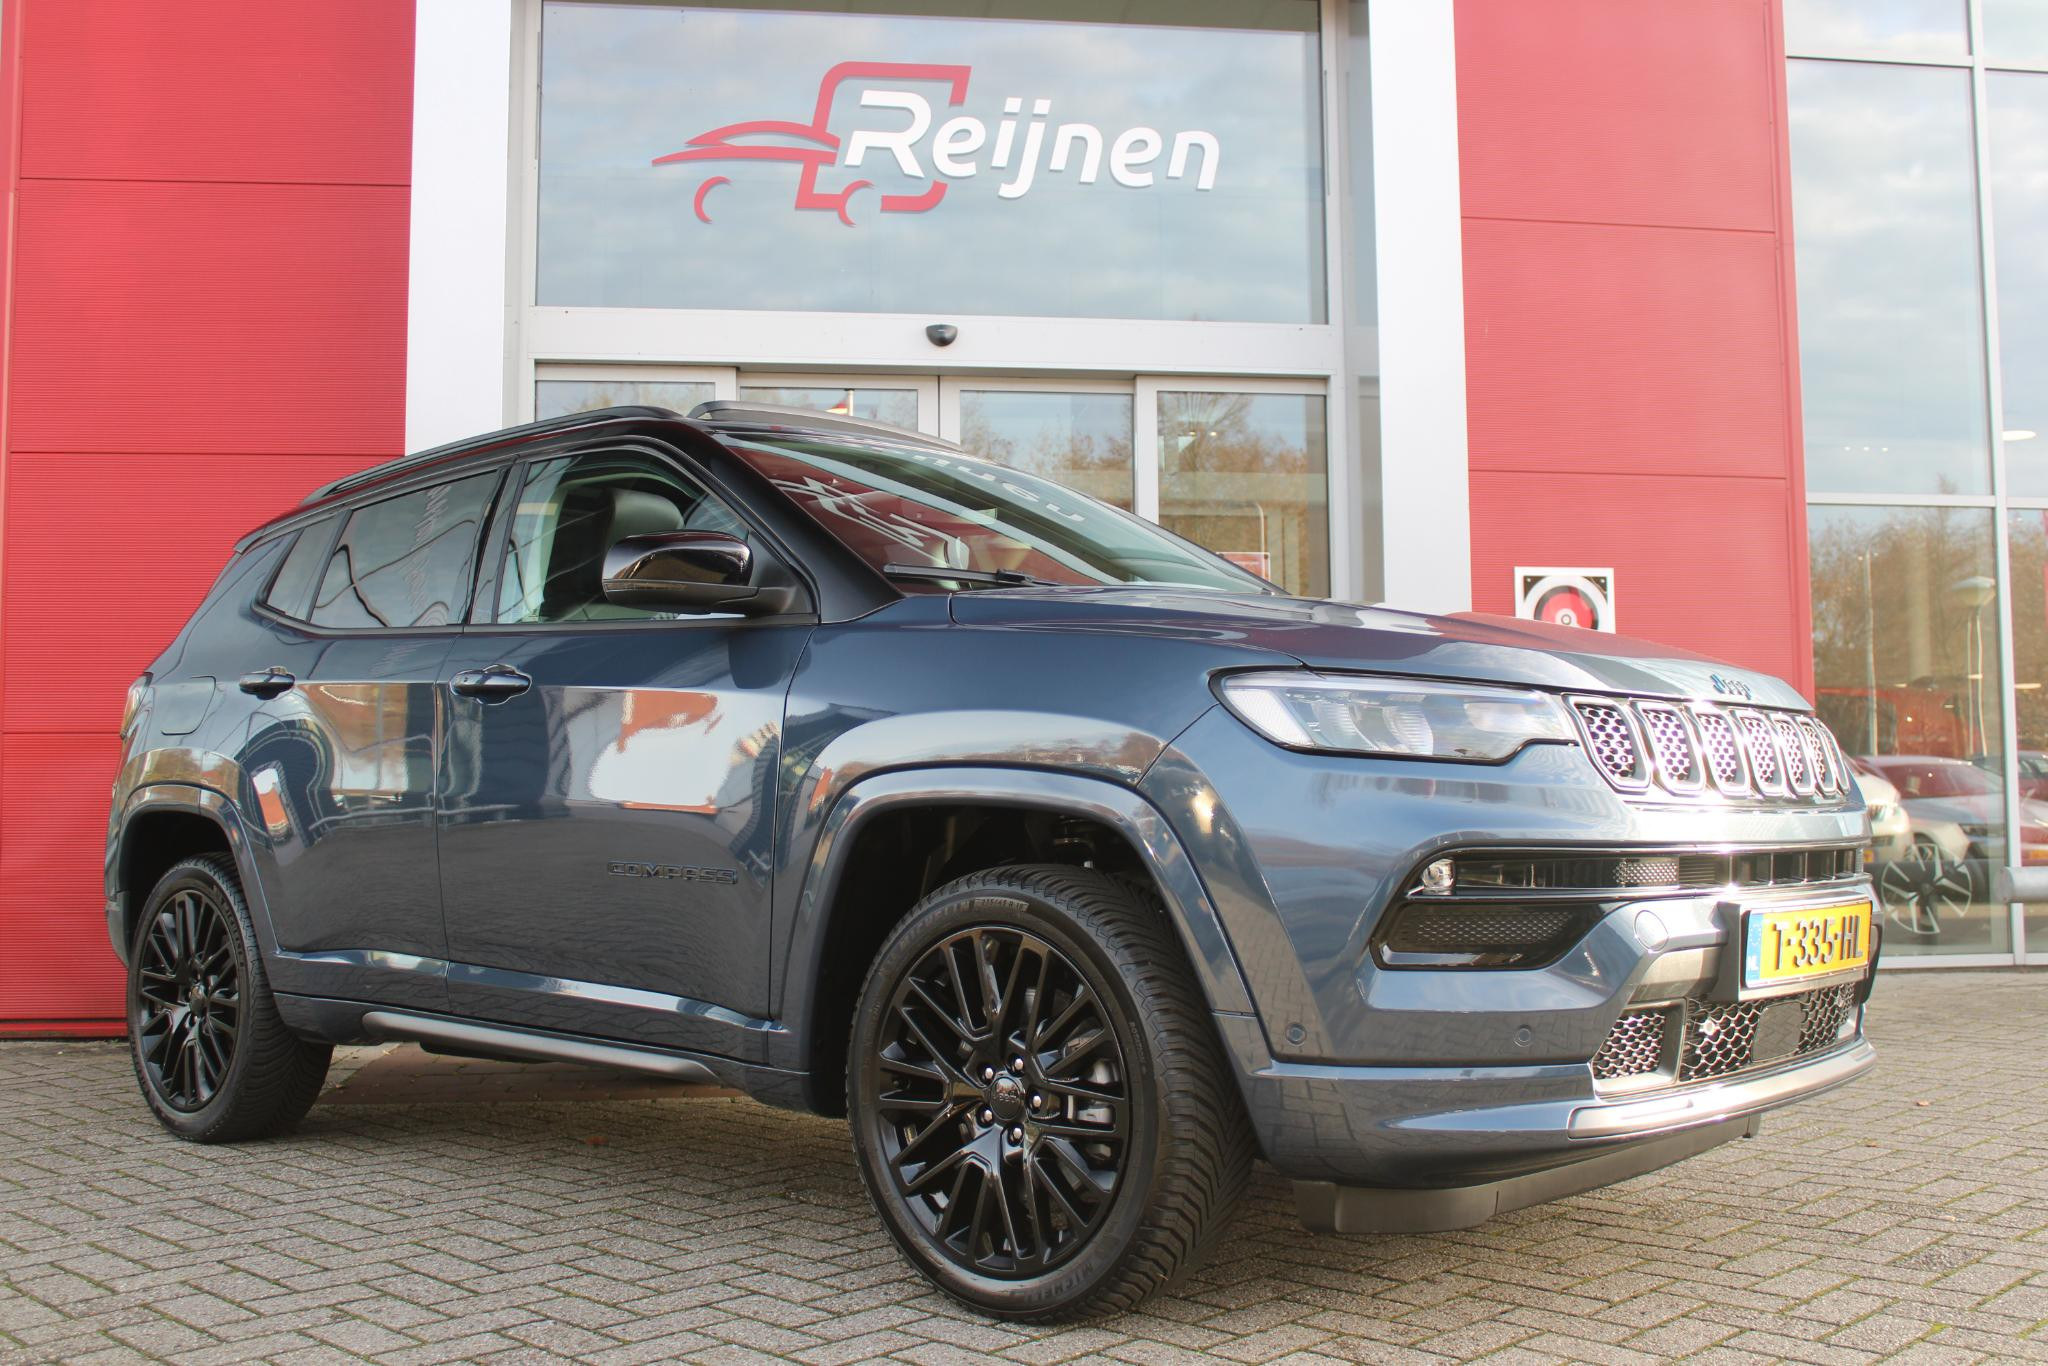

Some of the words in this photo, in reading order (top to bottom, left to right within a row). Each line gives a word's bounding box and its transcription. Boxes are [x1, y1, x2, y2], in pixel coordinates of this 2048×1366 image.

[844, 89, 1221, 200] Reijnen
[607, 860, 738, 884] COMPASS
[1772, 914, 1863, 971] T-335-HL
